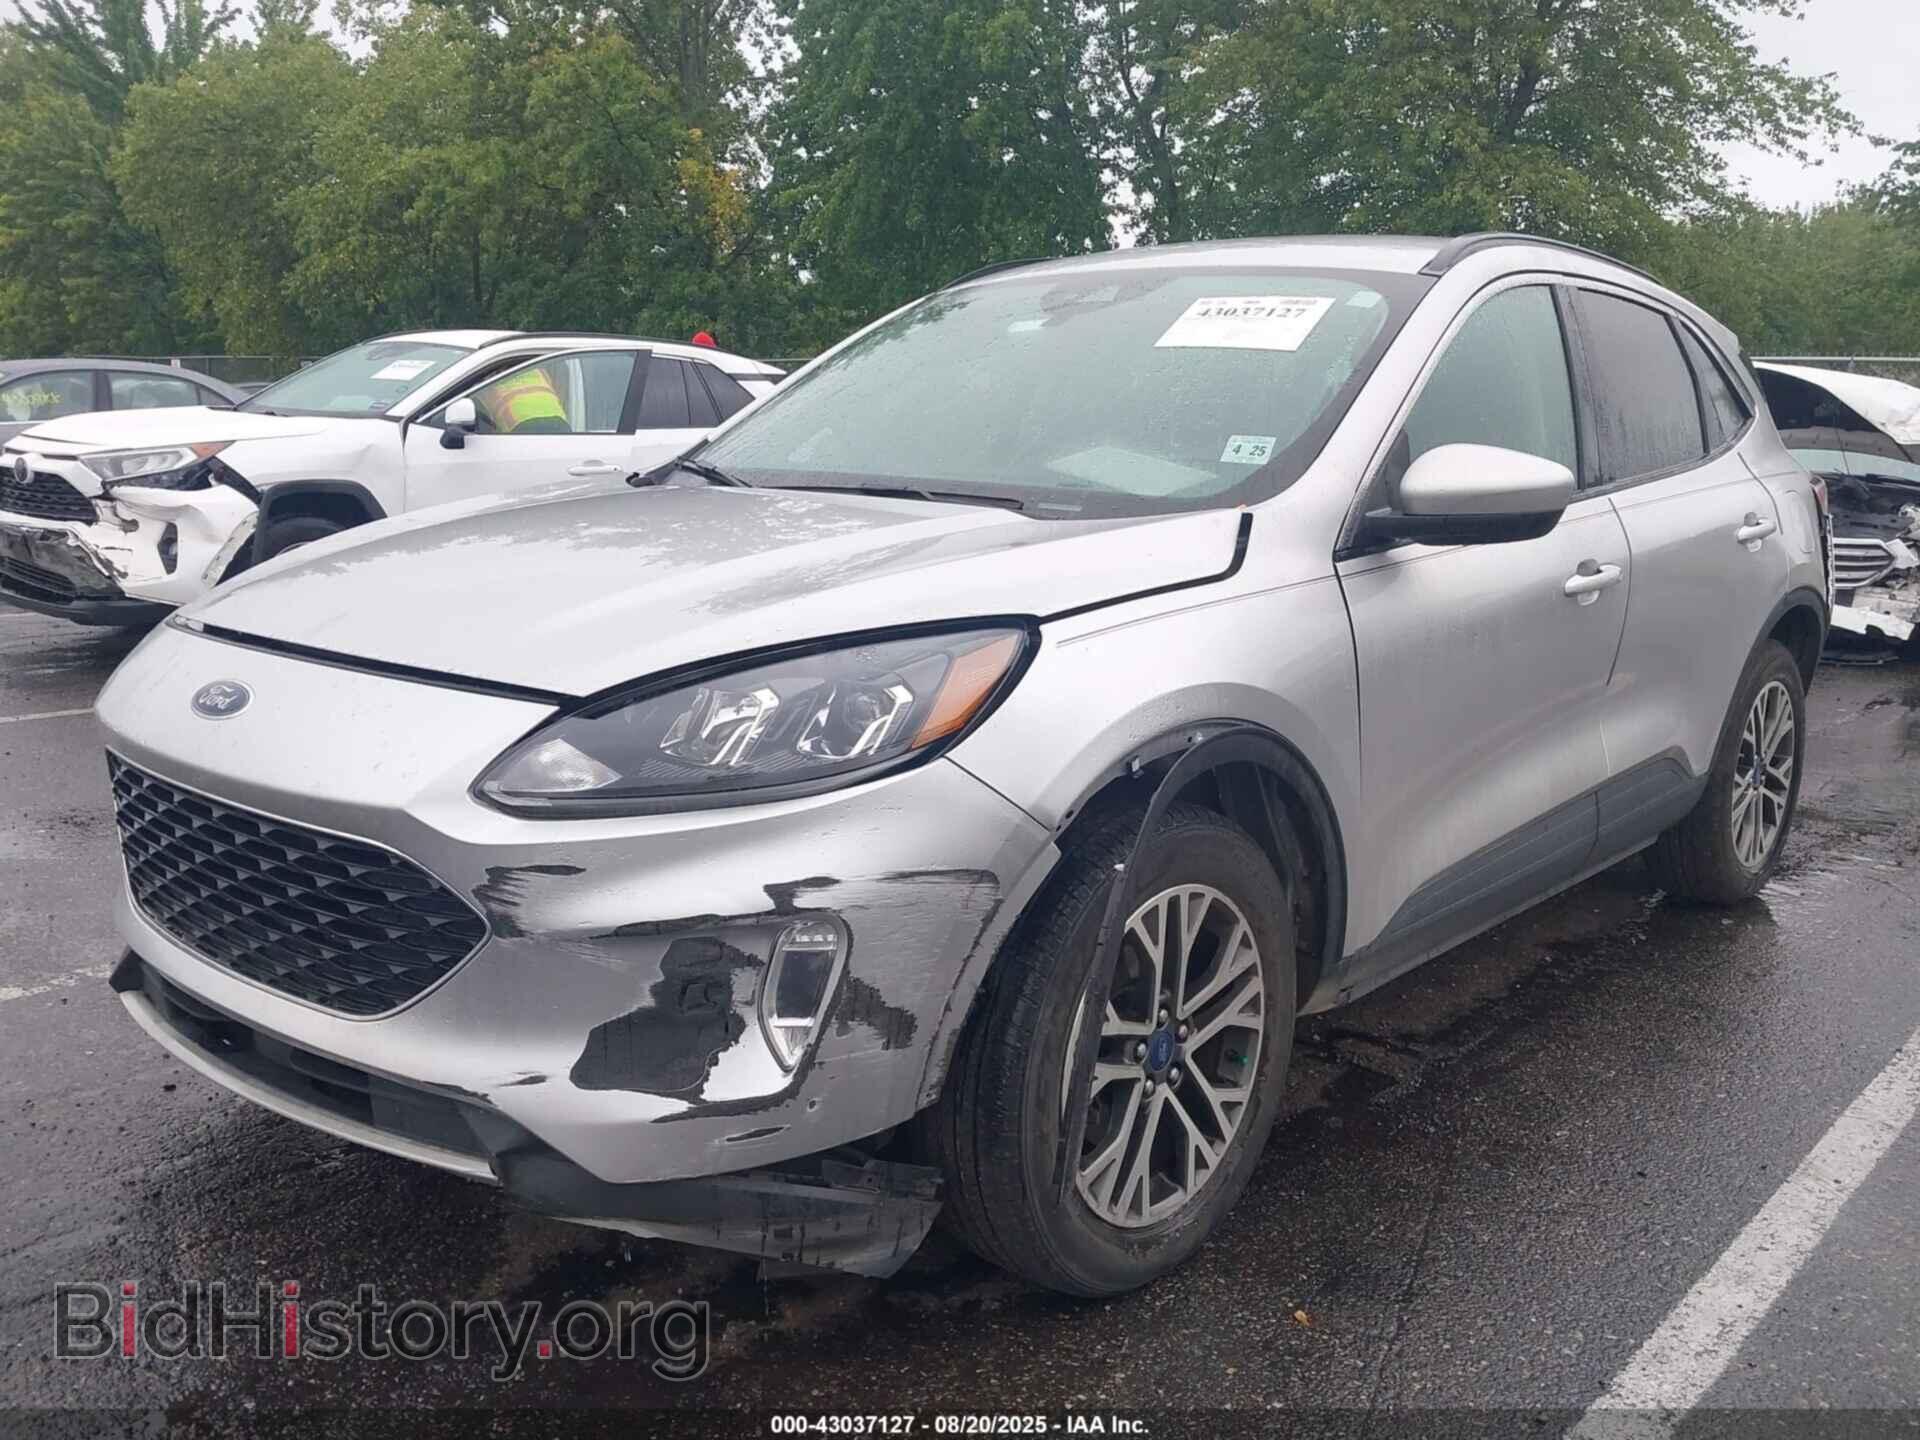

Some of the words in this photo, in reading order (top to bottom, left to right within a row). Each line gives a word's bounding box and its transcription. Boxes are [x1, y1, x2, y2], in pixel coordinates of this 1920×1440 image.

[1196, 306, 1308, 319] 43037127
[1232, 443, 1242, 455] 4
[1249, 444, 1267, 457] 25
[198, 684, 238, 710] Ford
